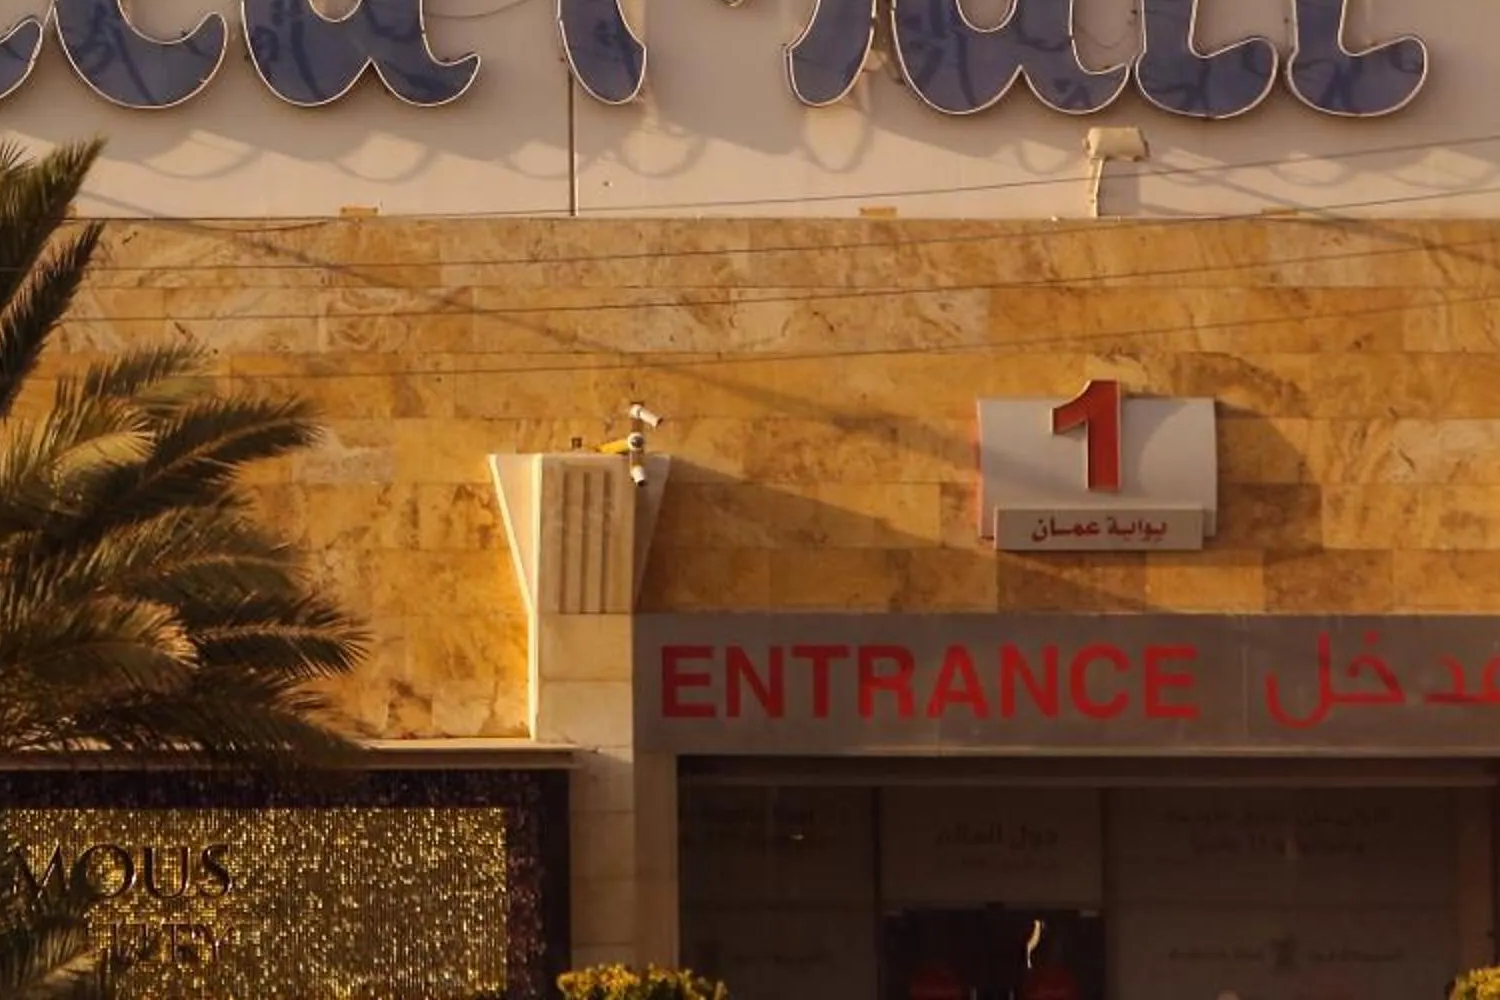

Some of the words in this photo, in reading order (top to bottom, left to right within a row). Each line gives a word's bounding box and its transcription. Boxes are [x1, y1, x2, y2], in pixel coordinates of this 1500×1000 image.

[1050, 379, 1121, 491] 1
[1030, 515, 1100, 542] عمان
[1106, 515, 1168, 542] بوابة
[659, 642, 1200, 721] ENTRANCE
